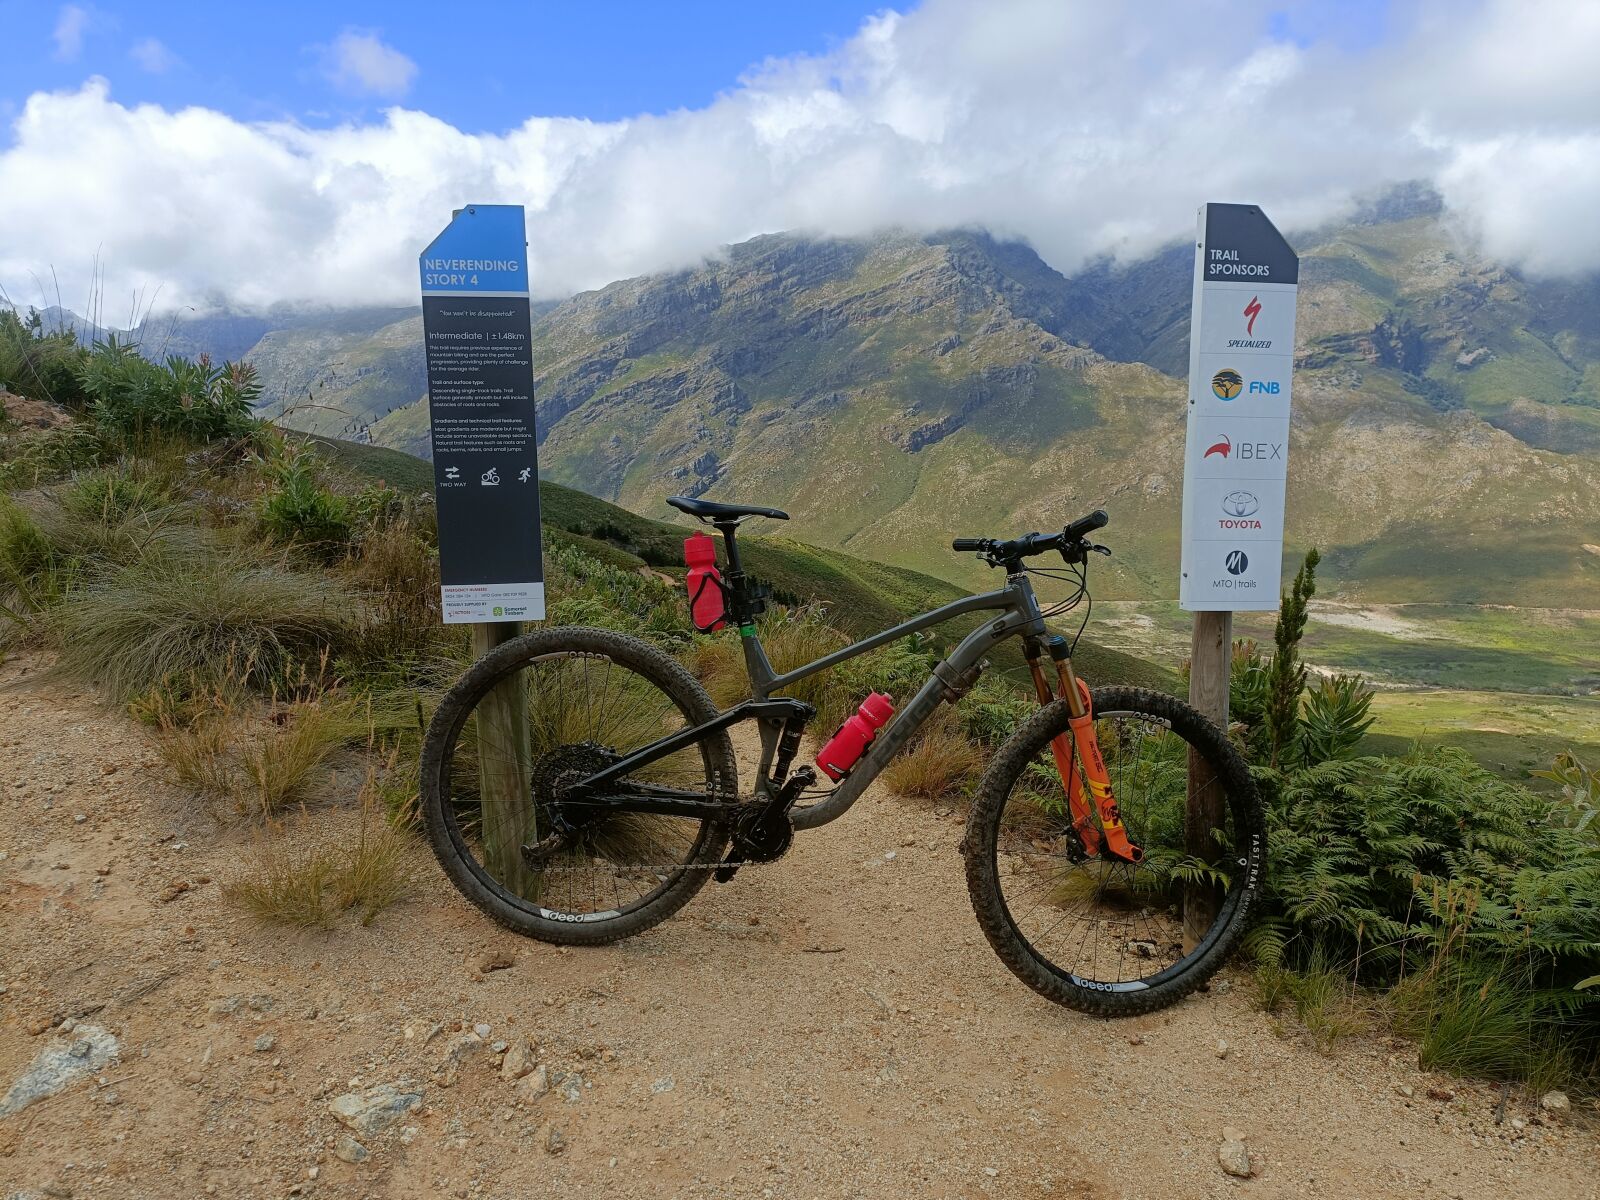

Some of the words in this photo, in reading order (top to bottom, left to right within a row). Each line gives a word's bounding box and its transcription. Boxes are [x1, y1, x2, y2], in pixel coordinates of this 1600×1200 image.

[1211, 250, 1239, 261] TRAIL
[425, 259, 518, 271] NEVERENDING
[1209, 264, 1270, 276] SPONSORS
[426, 274, 466, 285] STORY
[470, 275, 478, 285] 4
[1227, 339, 1272, 349] SPECIALIZED
[1249, 381, 1280, 395] FNB
[1236, 443, 1282, 459] IBEX
[1219, 520, 1261, 529] TOYOTA
[1213, 580, 1232, 588] MTO
[1238, 580, 1256, 588] trails
[1248, 863, 1259, 890] TRAK
[549, 912, 584, 923] deed
[1080, 980, 1113, 992] deed
